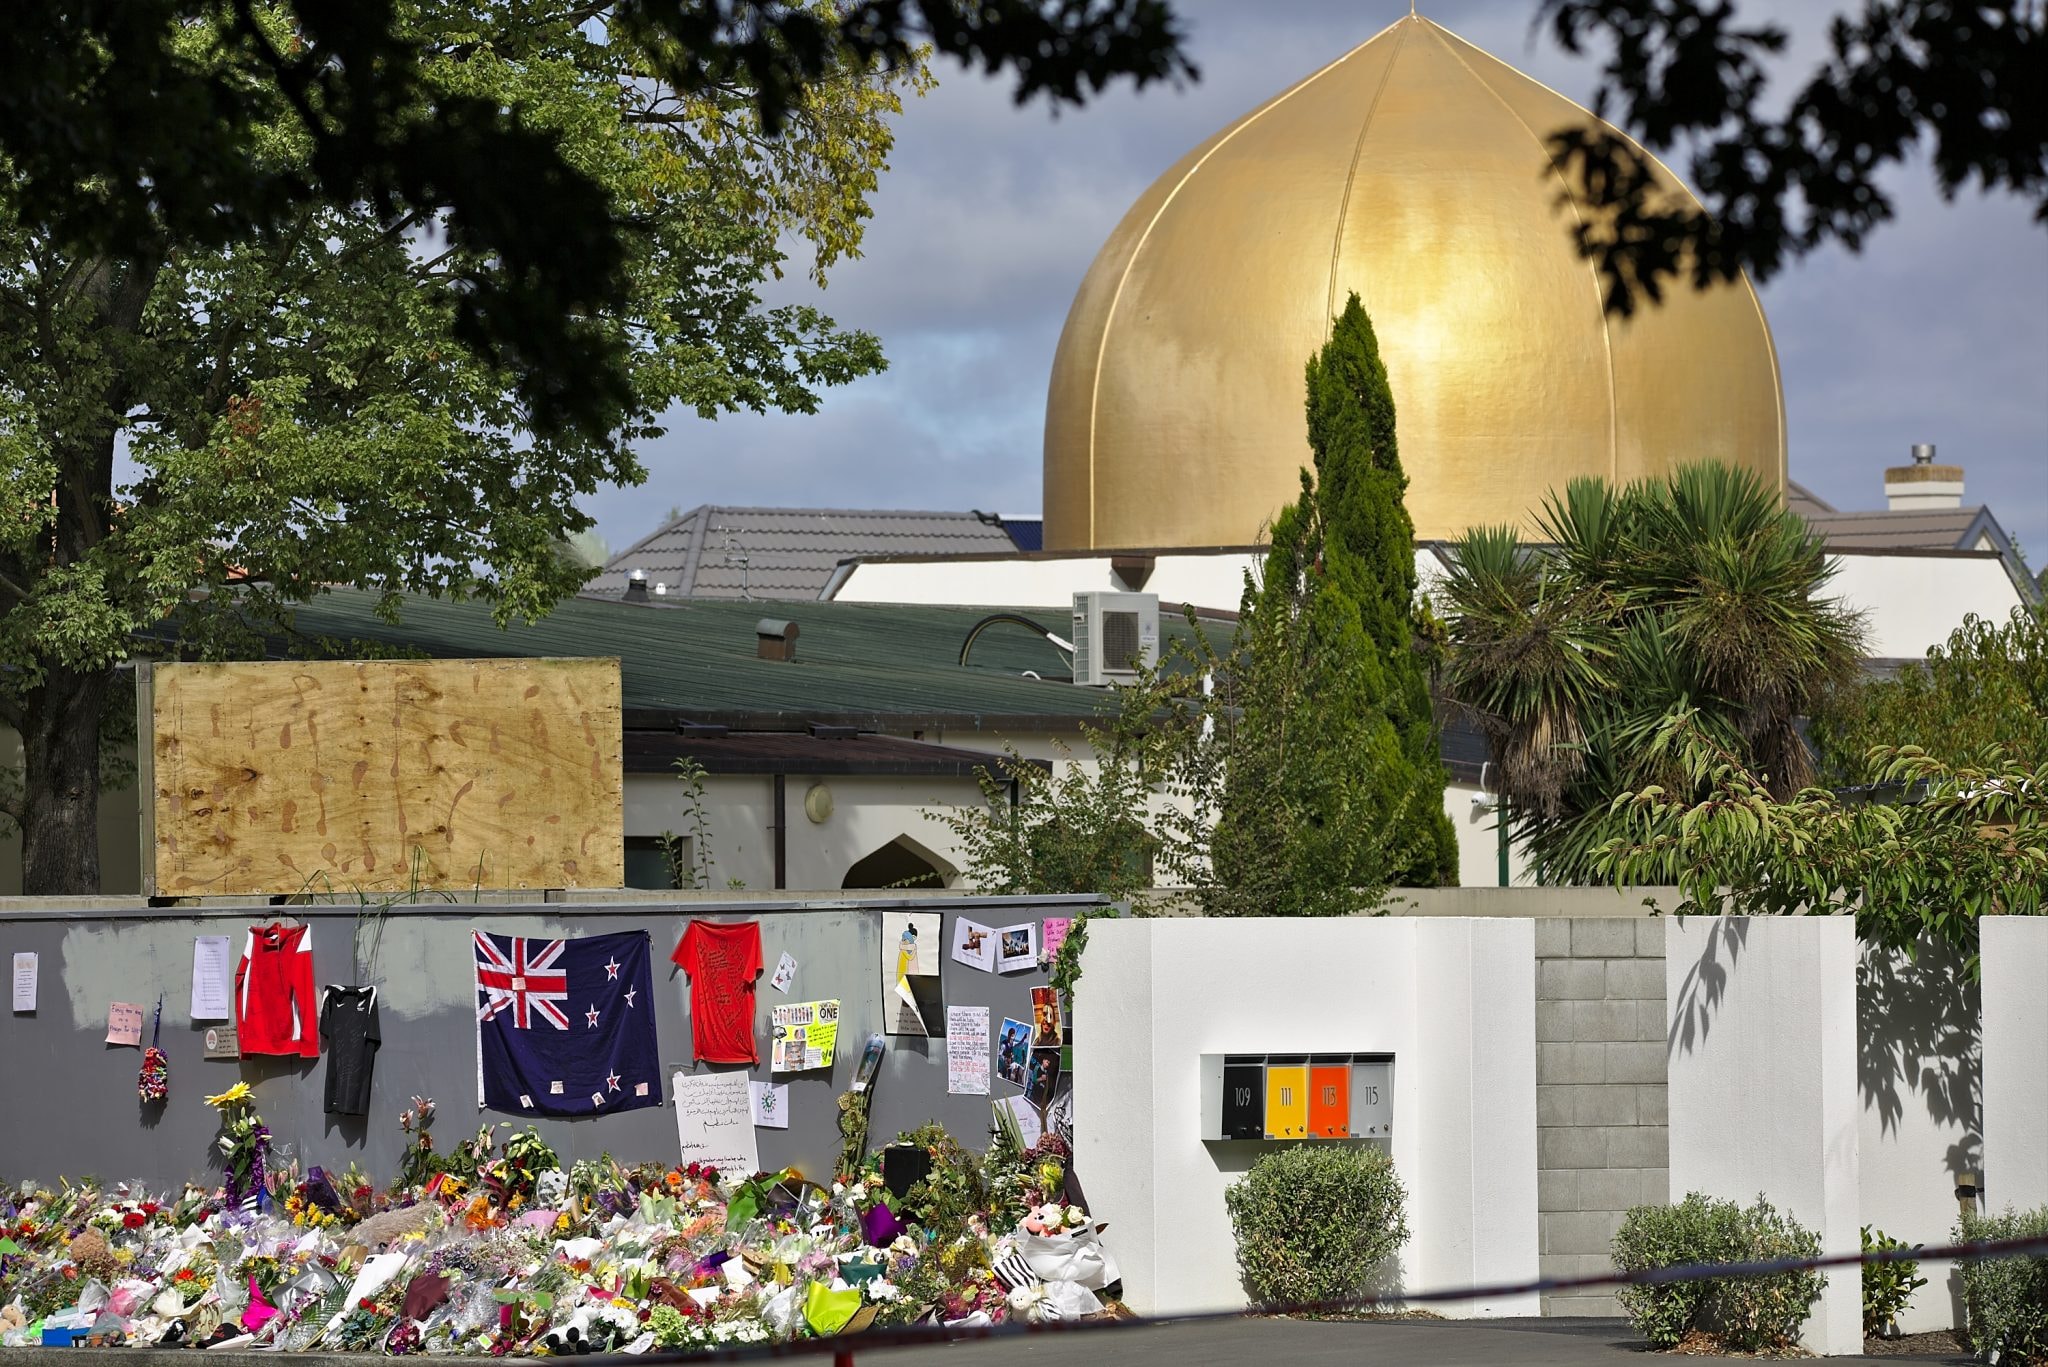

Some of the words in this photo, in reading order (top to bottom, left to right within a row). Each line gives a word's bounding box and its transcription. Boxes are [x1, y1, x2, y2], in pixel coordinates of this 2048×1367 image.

[820, 1007, 838, 1019] ONE
[1235, 1087, 1251, 1107] 109
[1280, 1087, 1293, 1107] 111
[1323, 1086, 1337, 1107] 113
[1365, 1086, 1379, 1106] 115
